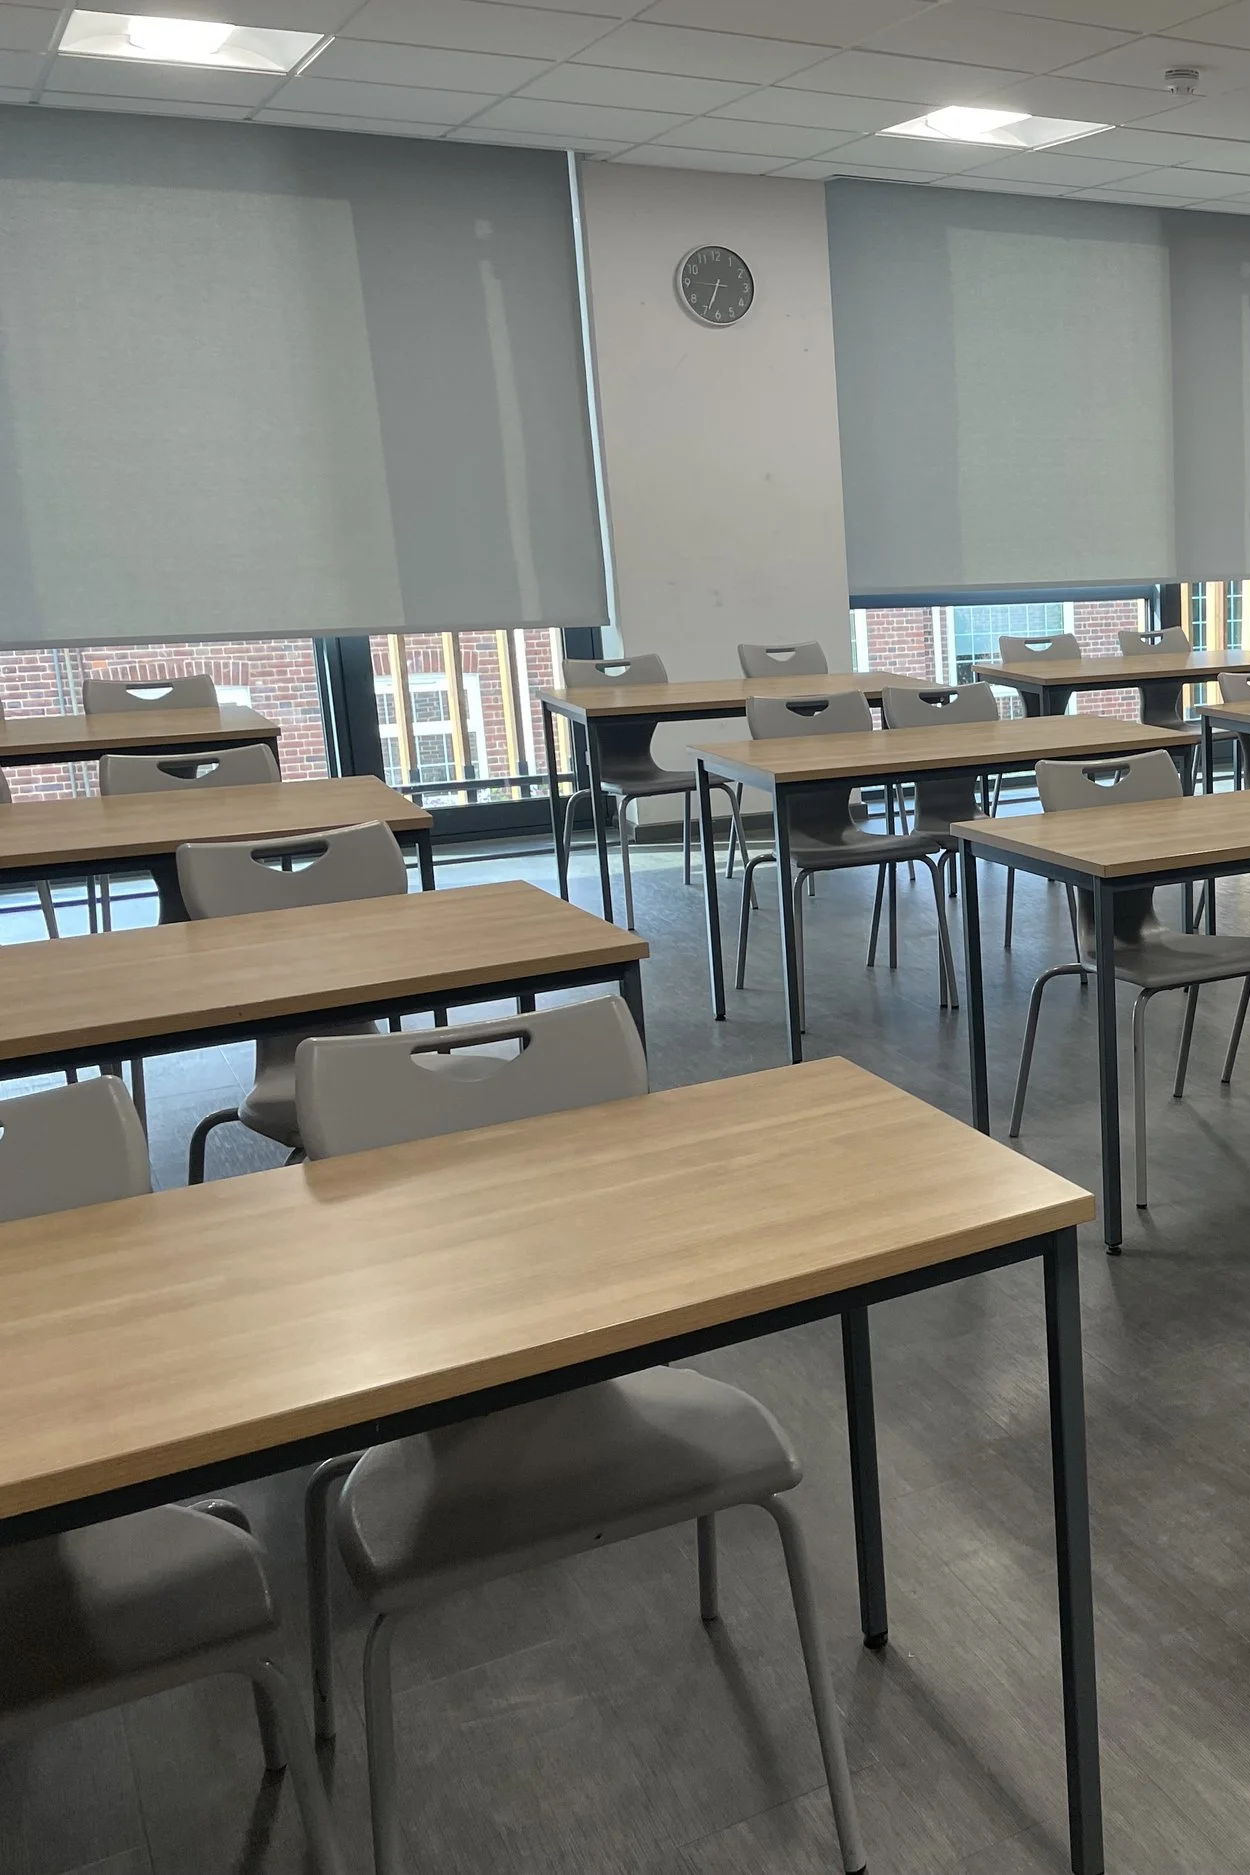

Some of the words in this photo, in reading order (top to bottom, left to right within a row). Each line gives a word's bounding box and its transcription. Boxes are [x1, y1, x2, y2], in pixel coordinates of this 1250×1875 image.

[698, 254, 707, 264] 11
[711, 251, 721, 261] 12
[728, 257, 732, 266] 1
[688, 265, 698, 275] 10
[737, 268, 744, 278] 2
[684, 278, 691, 287] 9
[743, 282, 750, 293] 3
[690, 293, 697, 303] 8
[738, 297, 744, 307] 4
[702, 305, 708, 315] 7
[715, 309, 722, 320] 6
[728, 307, 735, 318] 5
